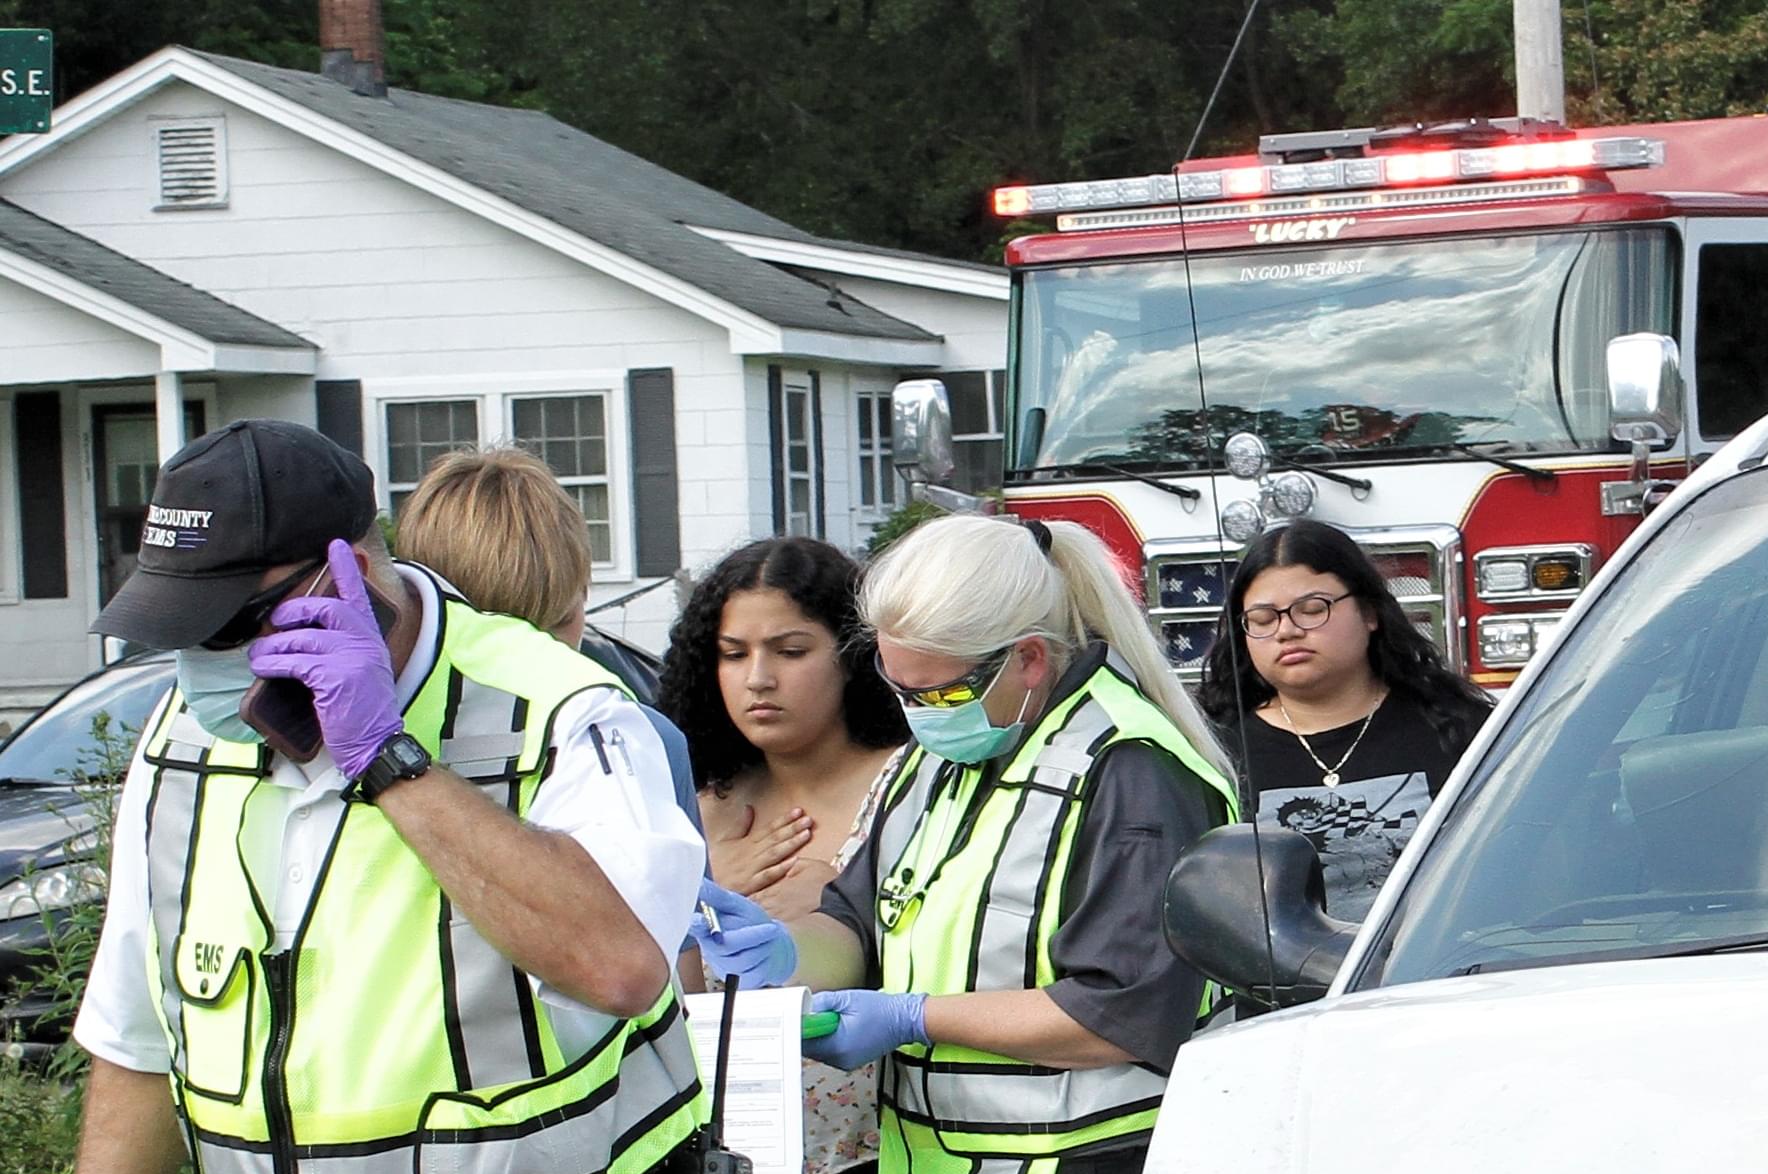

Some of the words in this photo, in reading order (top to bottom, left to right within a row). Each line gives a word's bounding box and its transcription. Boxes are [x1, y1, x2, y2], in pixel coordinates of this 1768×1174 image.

[1, 69, 51, 95] S.E.
[1240, 266, 1257, 281] IN
[1259, 264, 1290, 280] GOD
[1293, 262, 1318, 277] WE
[1319, 259, 1366, 275] TRUST
[160, 507, 213, 529] COUNTY
[194, 942, 225, 974] EMS
